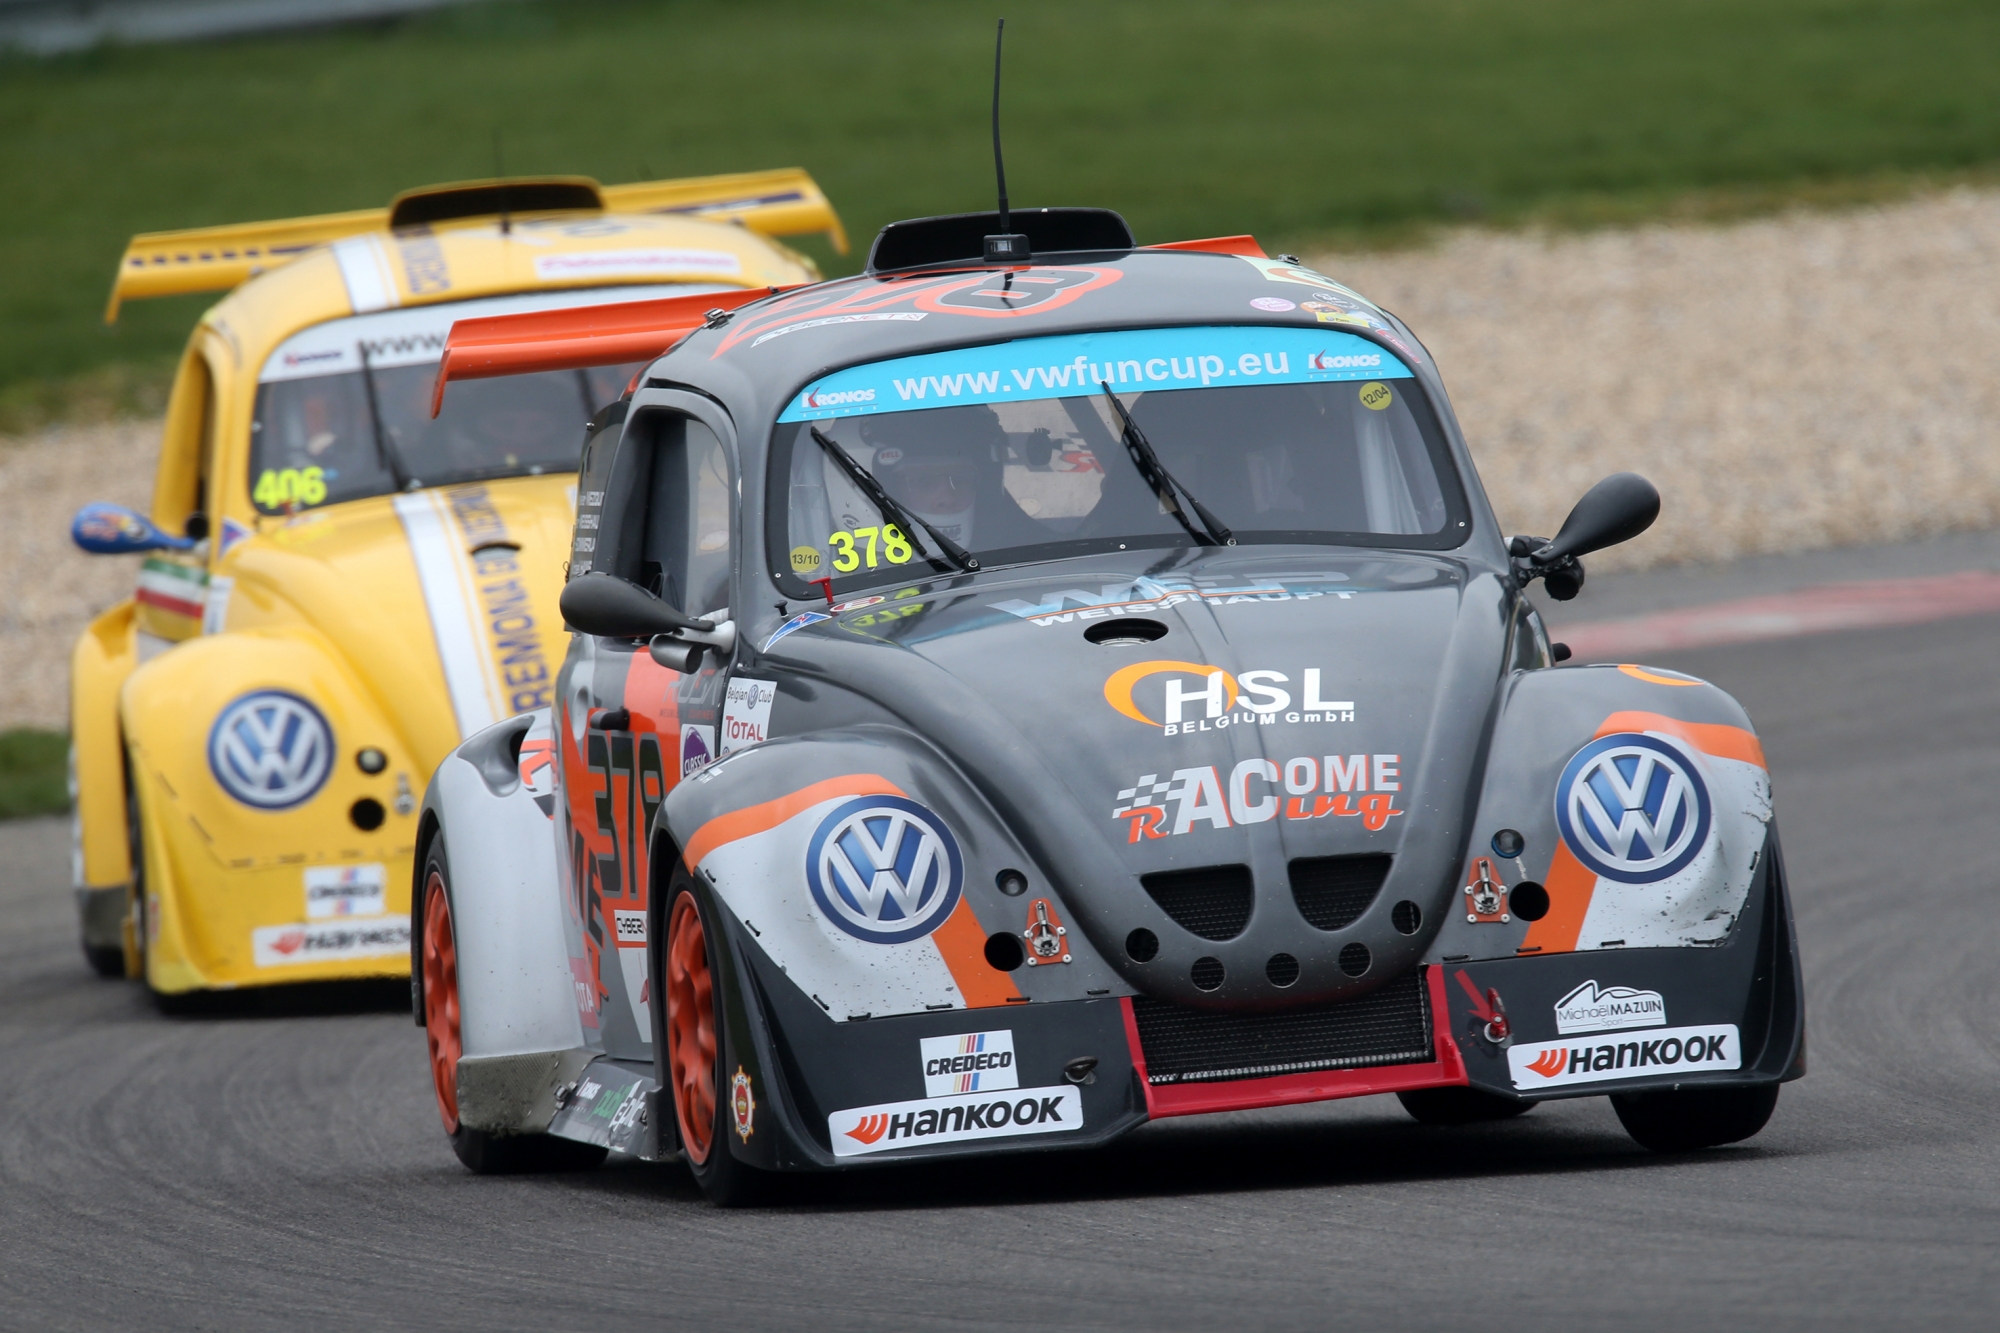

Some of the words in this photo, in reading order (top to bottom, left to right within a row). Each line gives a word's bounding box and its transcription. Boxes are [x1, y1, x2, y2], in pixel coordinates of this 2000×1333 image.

[1307, 349, 1381, 370] KRONOS
[892, 351, 1290, 401] www.vwfuncup.eu
[801, 387, 876, 408] KRONOS
[1362, 385, 1390, 406] 12/04
[881, 451, 900, 460] BELL
[253, 465, 328, 508] 406
[791, 554, 820, 566] 13/10
[828, 523, 913, 572] 378
[1029, 590, 1358, 628] WEISSHAUPT
[727, 686, 748, 704] Belgian
[758, 688, 773, 704] Club
[1165, 668, 1355, 724] HSL
[725, 715, 764, 742] TOTAL
[1164, 712, 1276, 737] BELGIUM
[1285, 710, 1355, 724] GmbH
[1601, 1017, 1625, 1027] Sport
[926, 1051, 1013, 1076] CREDECO
